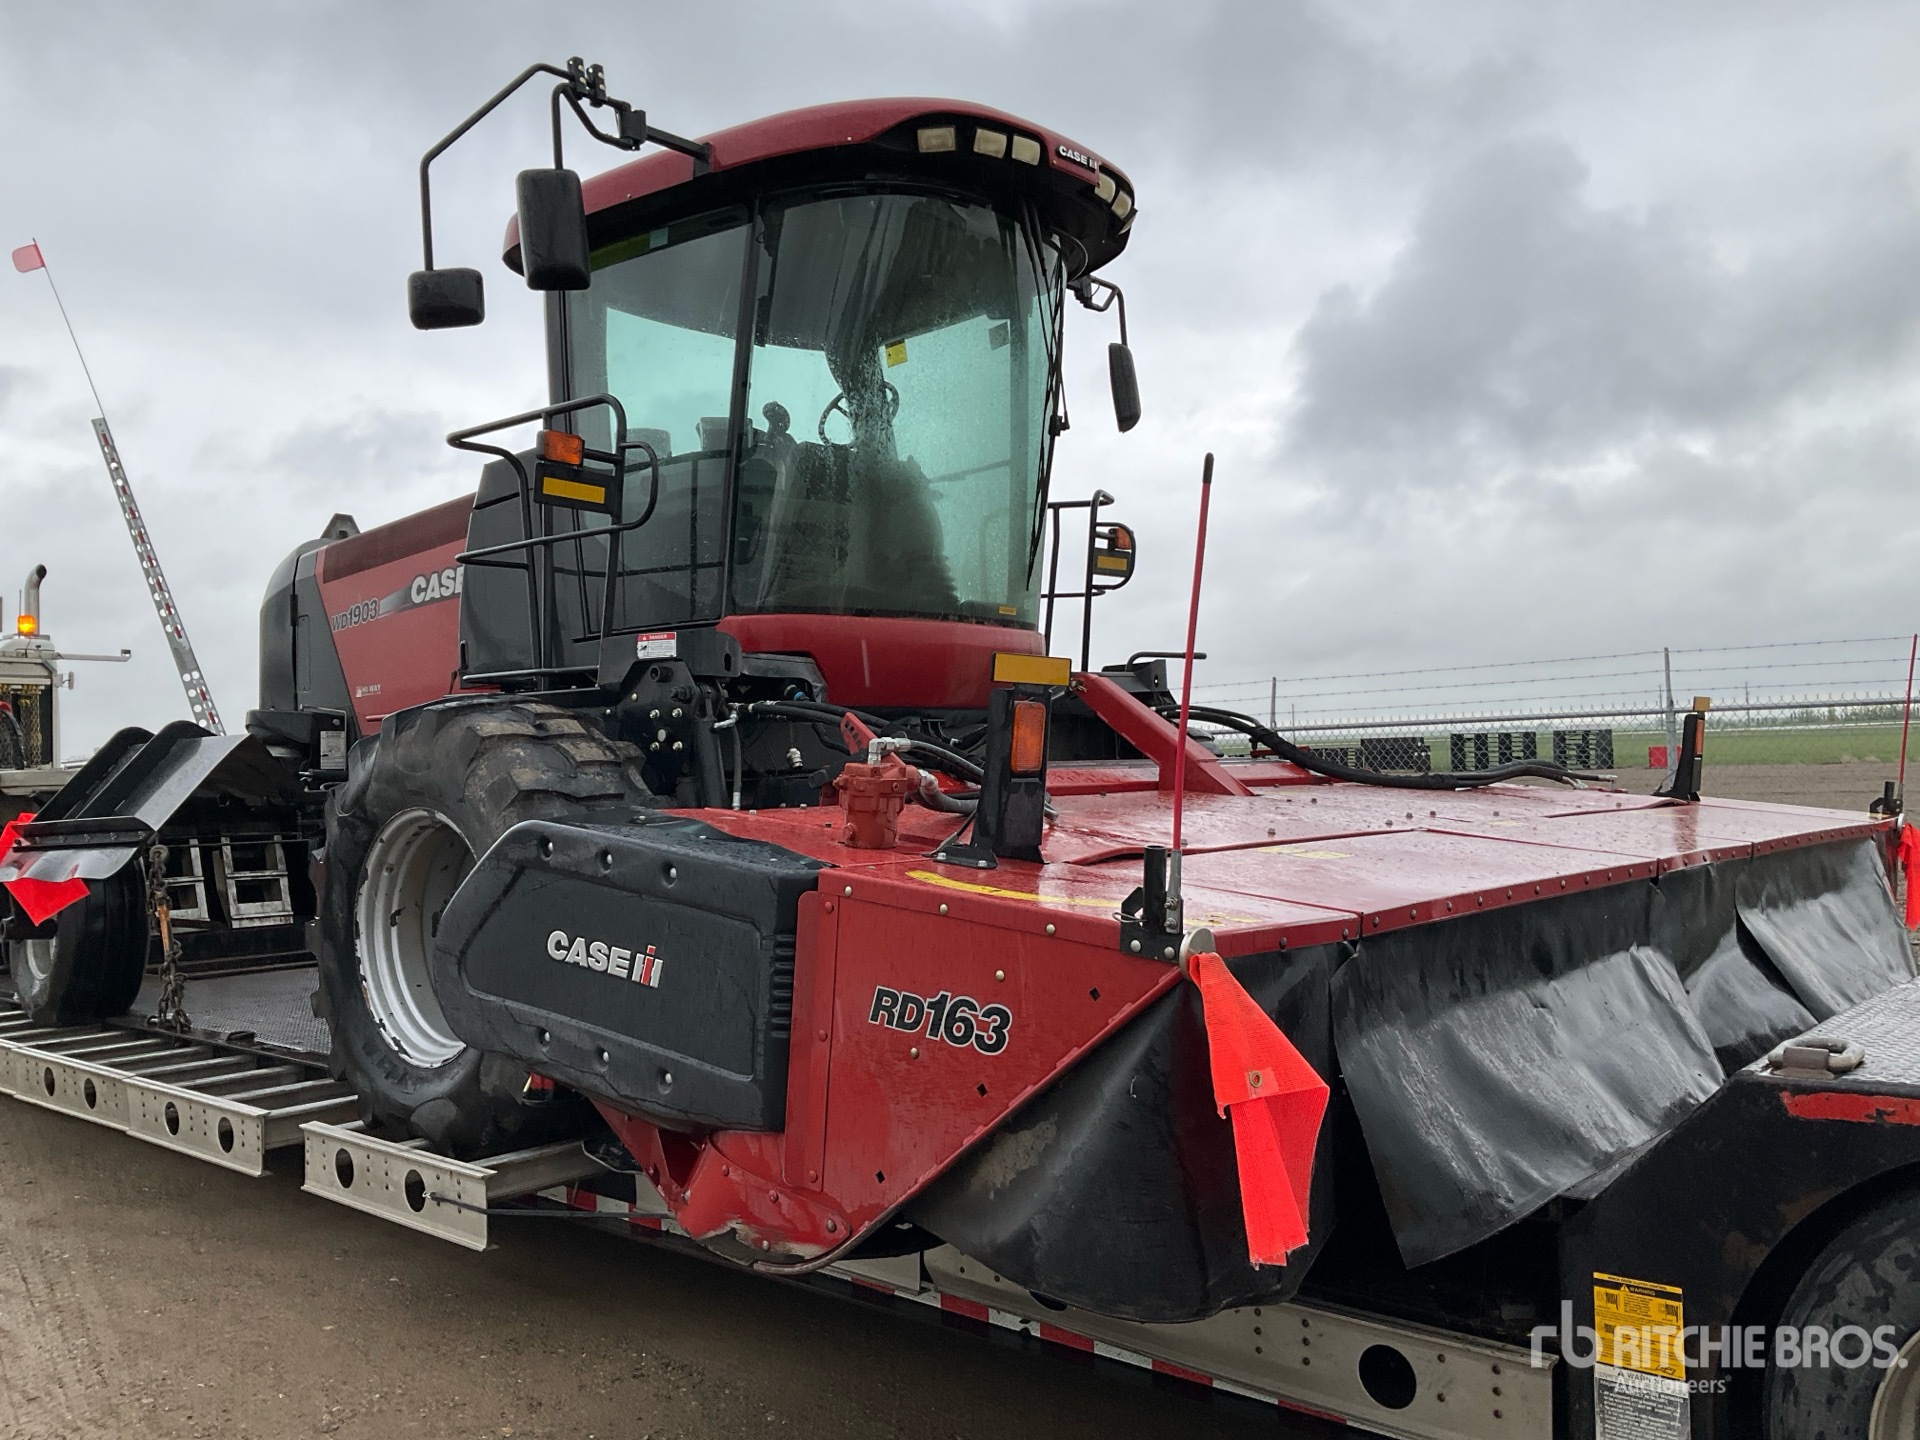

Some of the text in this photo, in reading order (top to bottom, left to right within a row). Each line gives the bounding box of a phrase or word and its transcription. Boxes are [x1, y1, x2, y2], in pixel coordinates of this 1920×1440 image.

[1059, 145, 1088, 165] CASE
[331, 598, 378, 633] WD1903
[547, 930, 632, 979] CASE
[868, 985, 1013, 1055] RD163
[1629, 1286, 1656, 1296] WARNING
